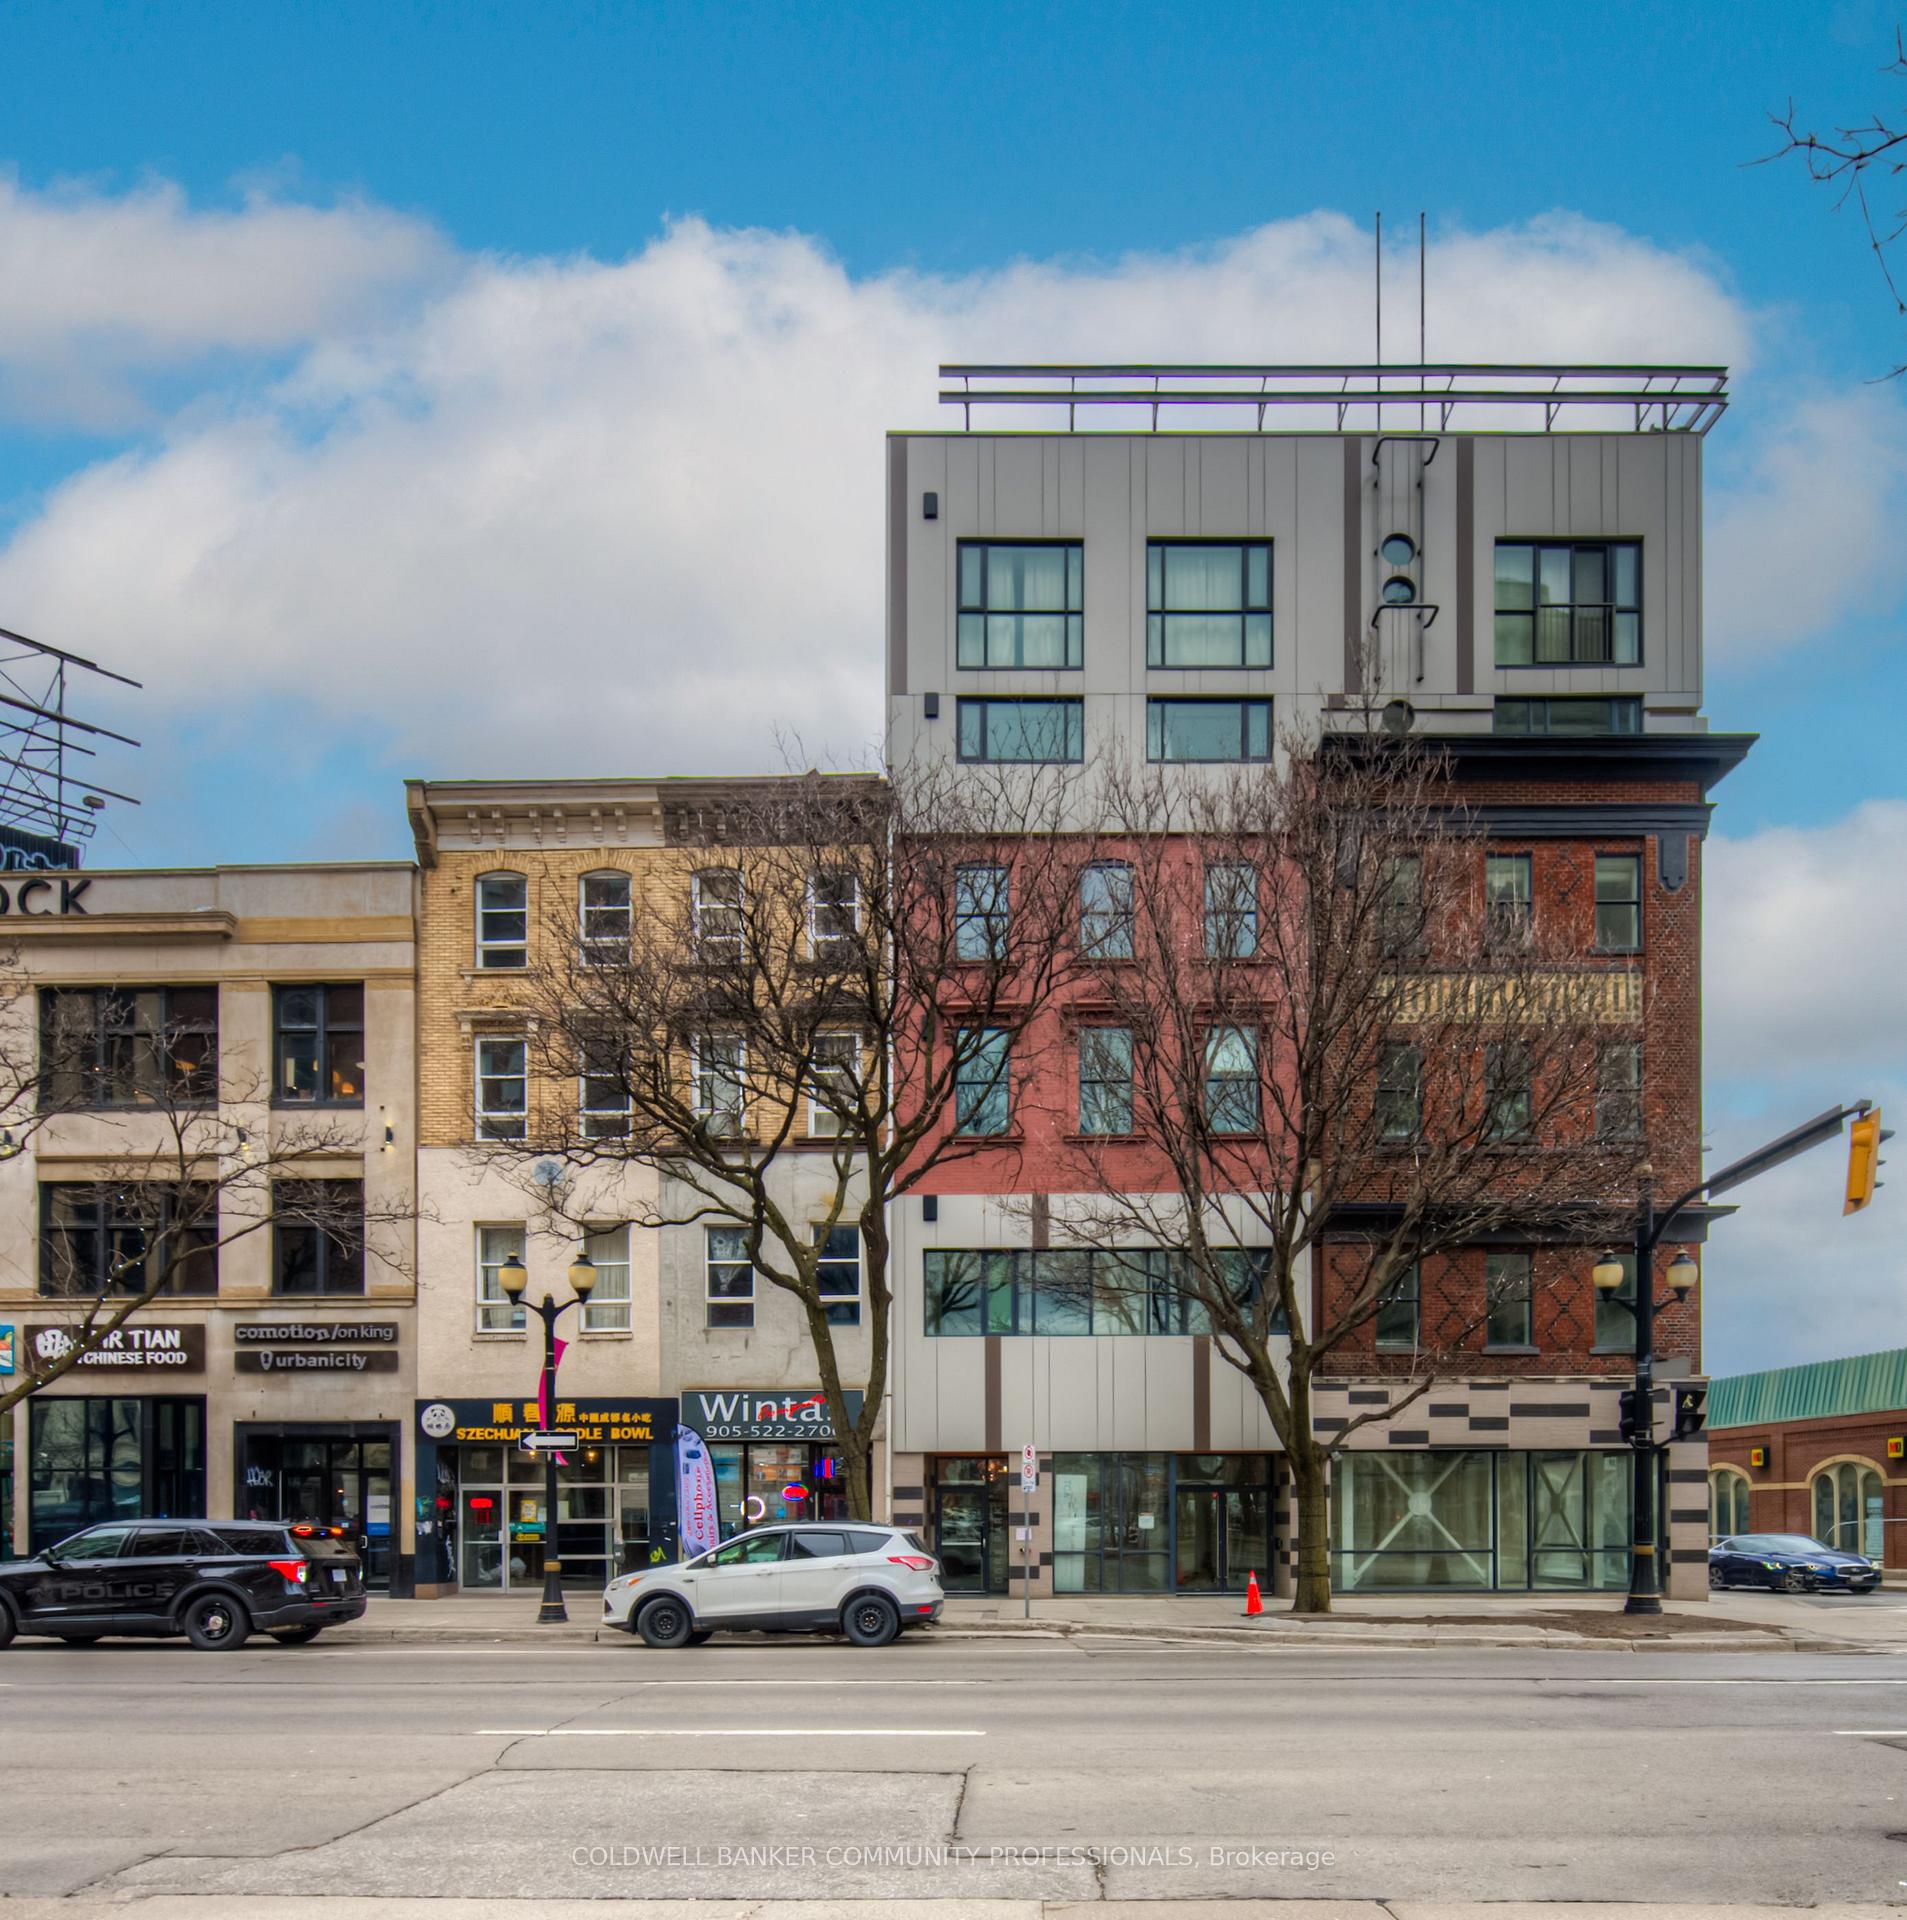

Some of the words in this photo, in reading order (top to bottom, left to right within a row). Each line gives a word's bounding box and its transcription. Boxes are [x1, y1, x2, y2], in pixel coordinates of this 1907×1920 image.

[0, 878, 91, 915] CK
[128, 1329, 181, 1349] TIAN
[361, 1325, 393, 1341] king
[83, 1352, 144, 1365] CHINESE
[146, 1352, 188, 1365] FOOD
[276, 1353, 367, 1370] urbanicity
[699, 1393, 832, 1422] Winta
[456, 1427, 535, 1440] SZECHUA
[611, 1427, 654, 1440] BOWL
[61, 1583, 175, 1600] POLICE
